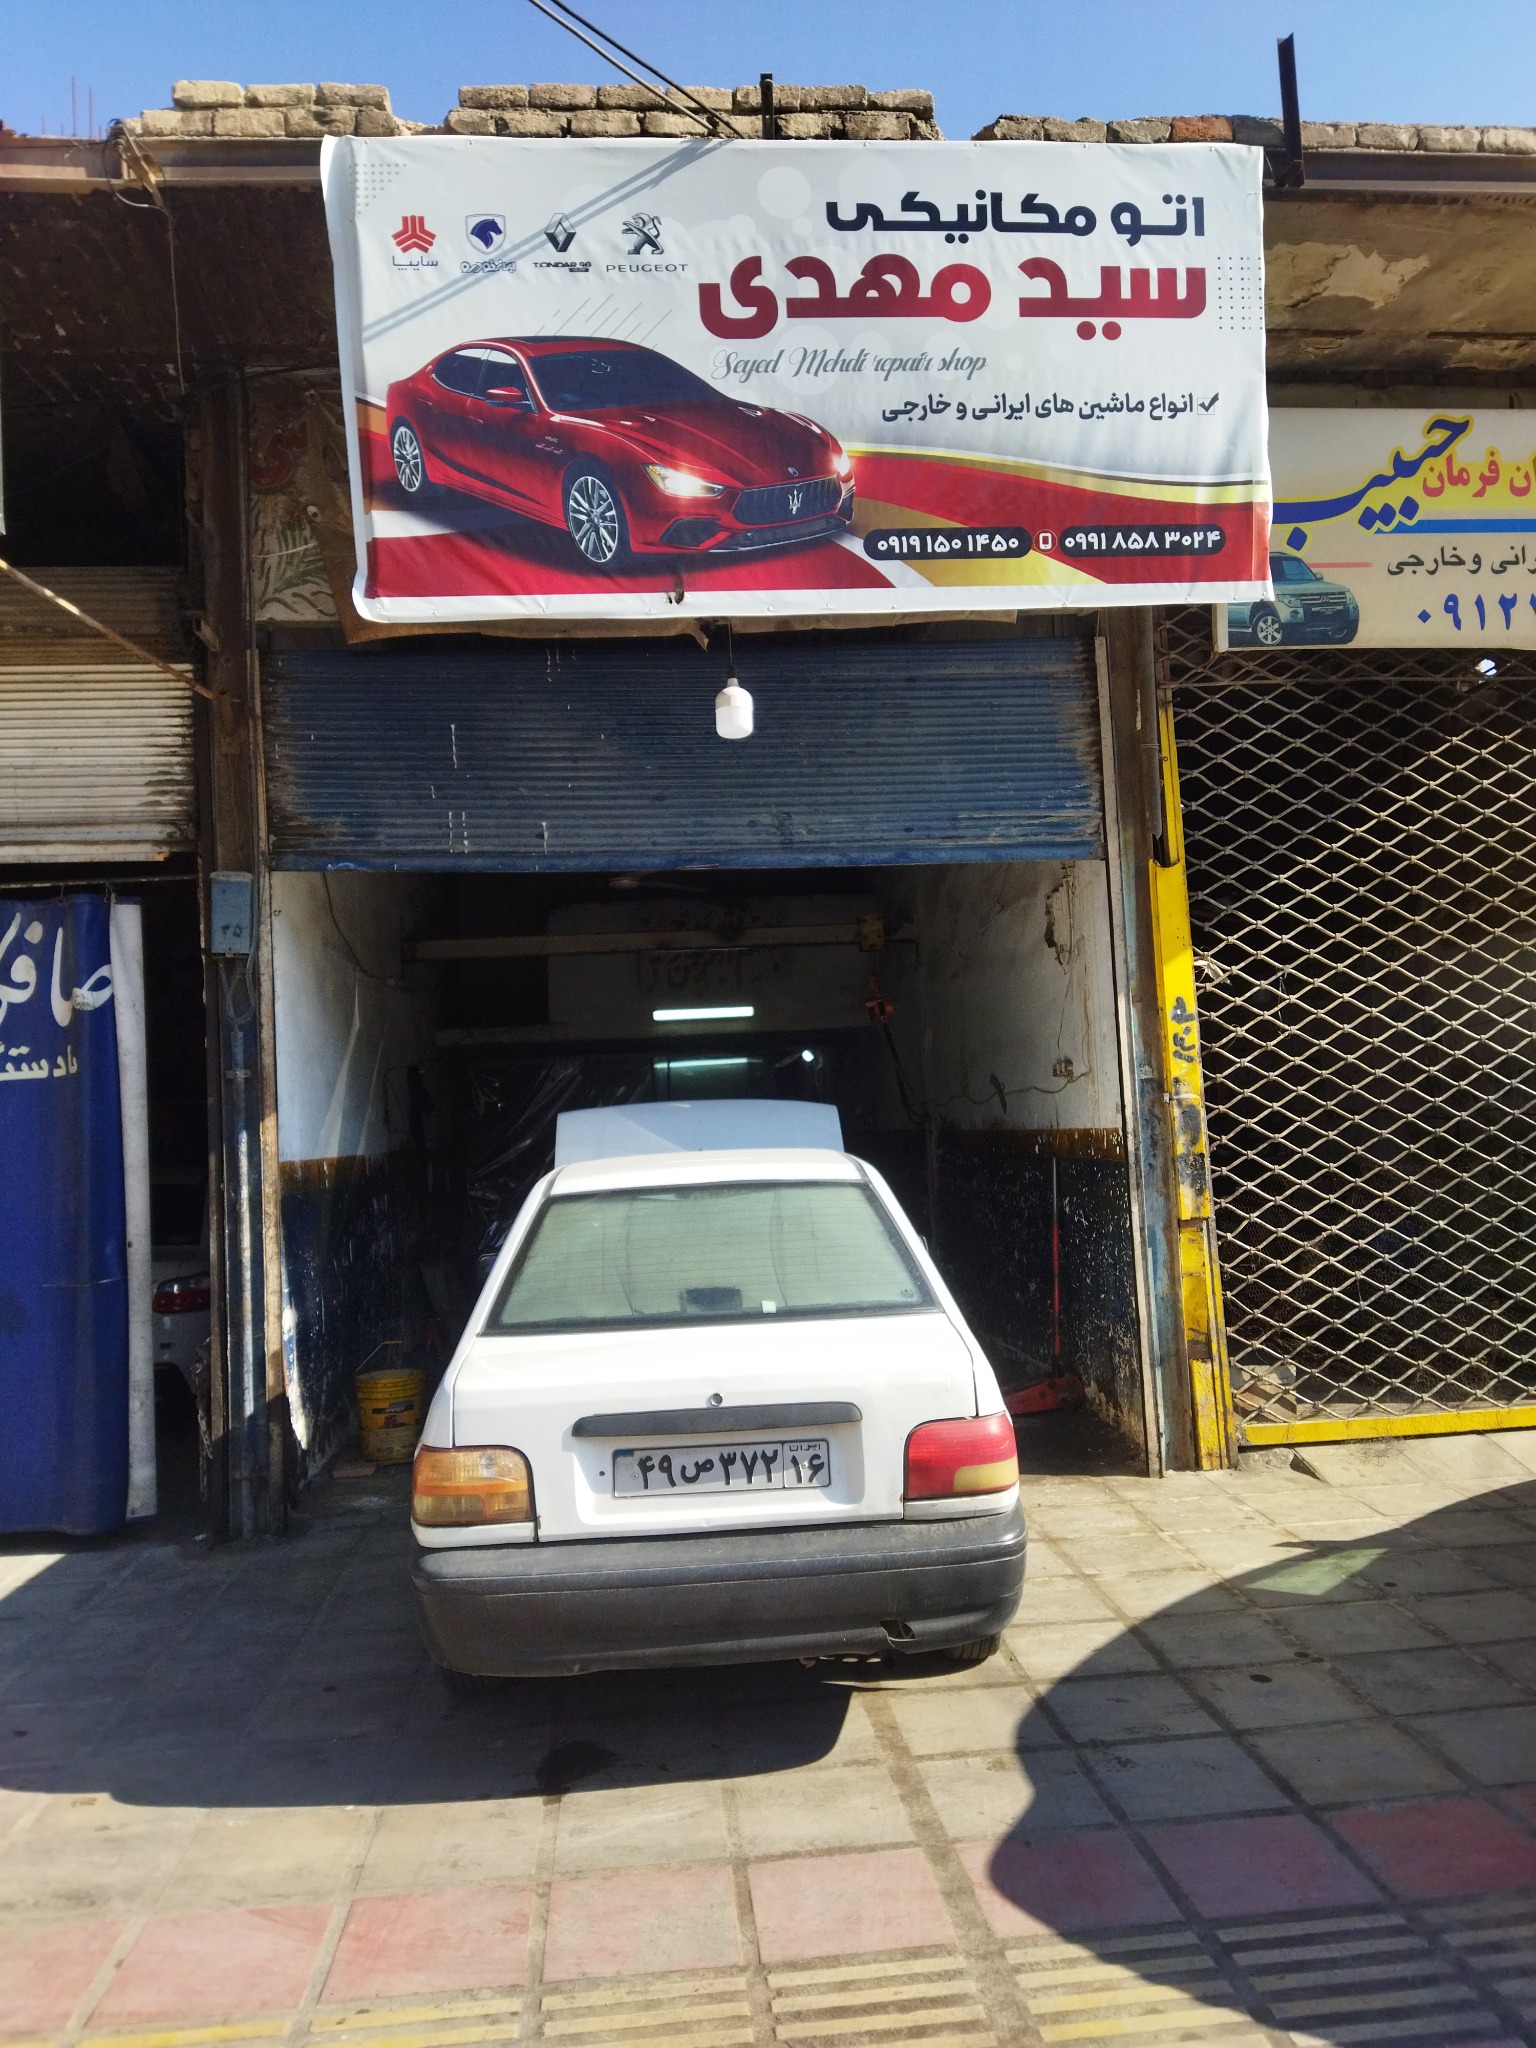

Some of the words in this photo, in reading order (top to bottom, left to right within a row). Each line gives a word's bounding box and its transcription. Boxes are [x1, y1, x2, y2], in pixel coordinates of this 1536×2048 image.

[826, 190, 1097, 244] مکانیکی
[1110, 193, 1205, 247] اتو
[605, 263, 689, 273] PEUGEOT
[698, 253, 992, 340] مهدی
[1019, 257, 1207, 341] سید
[789, 346, 869, 378] Mehdi
[873, 351, 933, 382] repair
[937, 347, 988, 381] shop
[881, 393, 952, 423] خارجی
[955, 402, 968, 421] و
[972, 392, 1031, 421] ایرانی
[1034, 393, 1074, 419] های
[1078, 392, 1145, 421] ماشین
[1149, 392, 1193, 421] انواع
[1422, 450, 1500, 498] فرمان
[877, 535, 921, 554] ۰۹۱۹
[926, 534, 962, 553] ۱۵۰
[967, 533, 1019, 552] ۱۴۵۰
[1064, 532, 1107, 550] ۰۹۹۱
[1112, 531, 1160, 550] ۸۵۸
[1164, 530, 1221, 549] ۳۰۲۴
[1417, 593, 1536, 631] ۰۹۱۲
[789, 1443, 822, 1452] ایران
[790, 1453, 825, 1484] ۱۶
